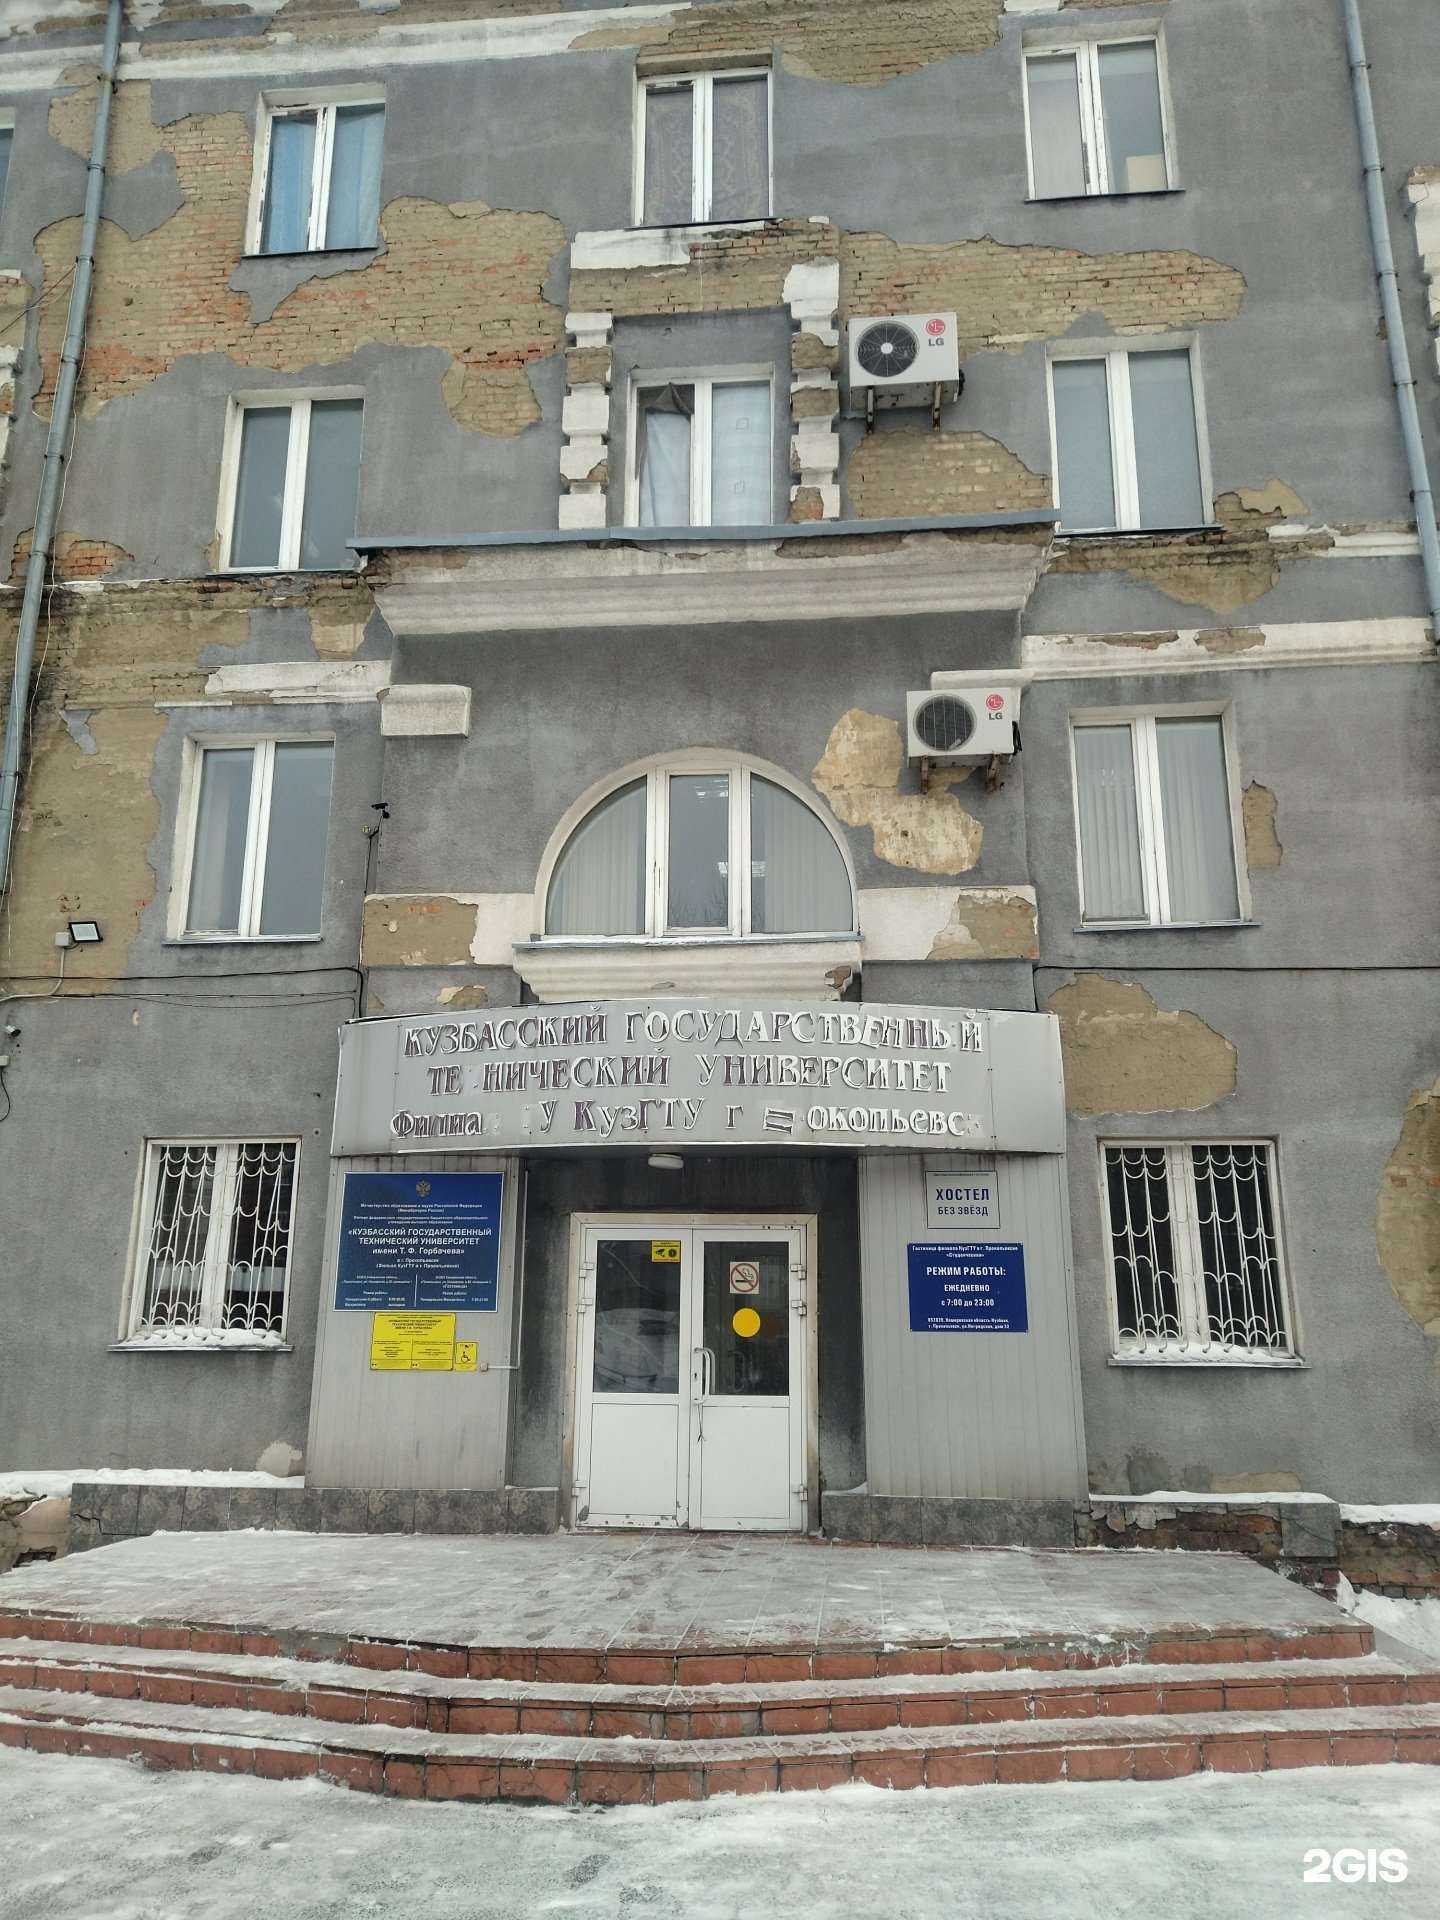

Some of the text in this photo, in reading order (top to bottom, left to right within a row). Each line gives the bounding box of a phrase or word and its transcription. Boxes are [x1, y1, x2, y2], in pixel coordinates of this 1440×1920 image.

[928, 337, 945, 347] LG
[988, 712, 1004, 721] LG
[403, 1003, 608, 1057] КУЗБАССКИЙ
[427, 1047, 952, 1096] ТЕНИЧЕСКИЙ УНИВЕРСИТЕТ
[390, 1109, 486, 1139] Филиа
[573, 1097, 705, 1138] КузГТУ
[936, 1188, 990, 1200] ХОСТЕЛ
[938, 1205, 989, 1216] БЕЗ ЗВЁЗД
[408, 1227, 492, 1236] ГОСУДАРСТВЕННЫЙ
[359, 1237, 480, 1245] ТЕХНИЧЕСКИЙ УНИВЕРСИТЕТ
[926, 1266, 1006, 1276] РЕЖИМ РАБОТЫ:
[944, 1284, 990, 1292] ЕЖЕДНЕВНО
[946, 1298, 962, 1306] 7:00
[974, 1298, 995, 1306] 23:00
